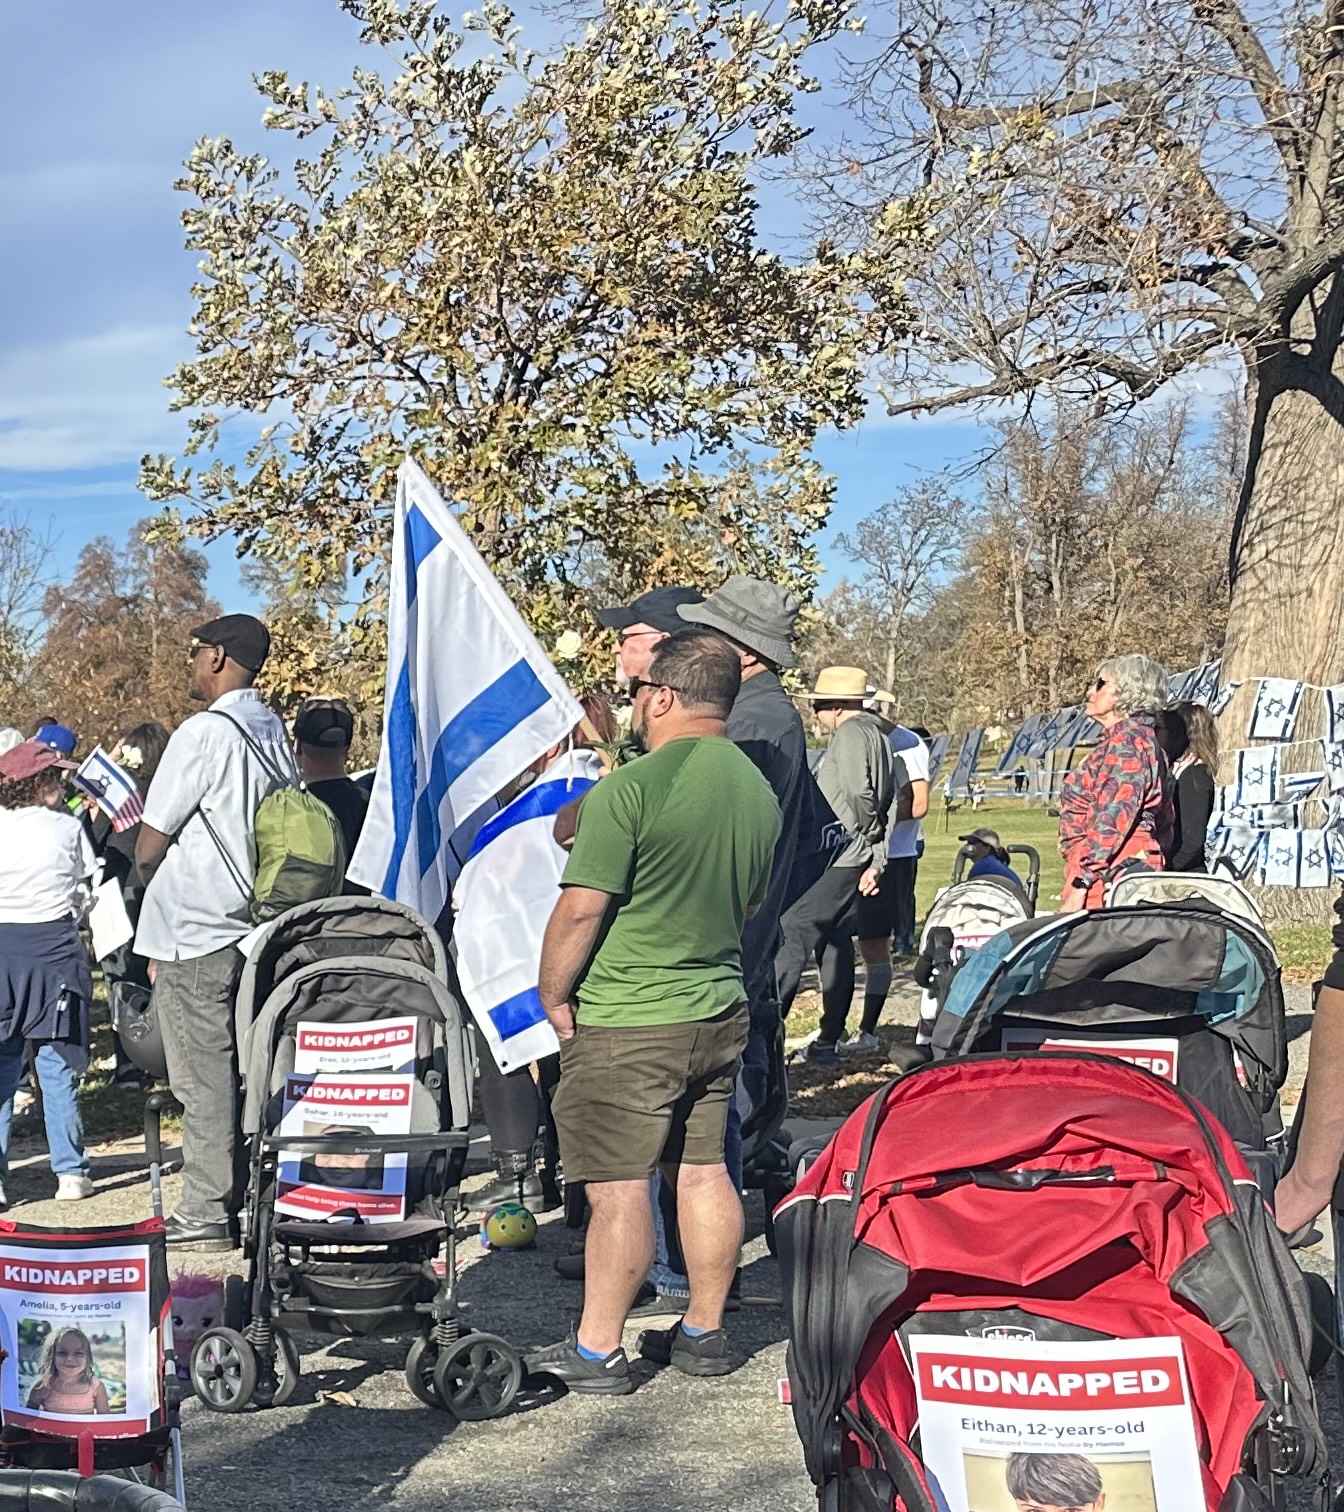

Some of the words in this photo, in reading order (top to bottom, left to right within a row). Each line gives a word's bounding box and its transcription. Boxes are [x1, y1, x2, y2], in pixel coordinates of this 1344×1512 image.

[303, 1028, 410, 1048] KIDNAPPED
[292, 1084, 406, 1101] KIDNAPPED
[3, 1264, 141, 1286] KIDNAPPED
[19, 1298, 58, 1312] Amelia,
[60, 1300, 122, 1313] 5-years-old
[930, 1364, 1171, 1398] KIDNAPPED
[960, 1417, 1023, 1437] Eithan,
[1026, 1420, 1146, 1440] 12-years-old
